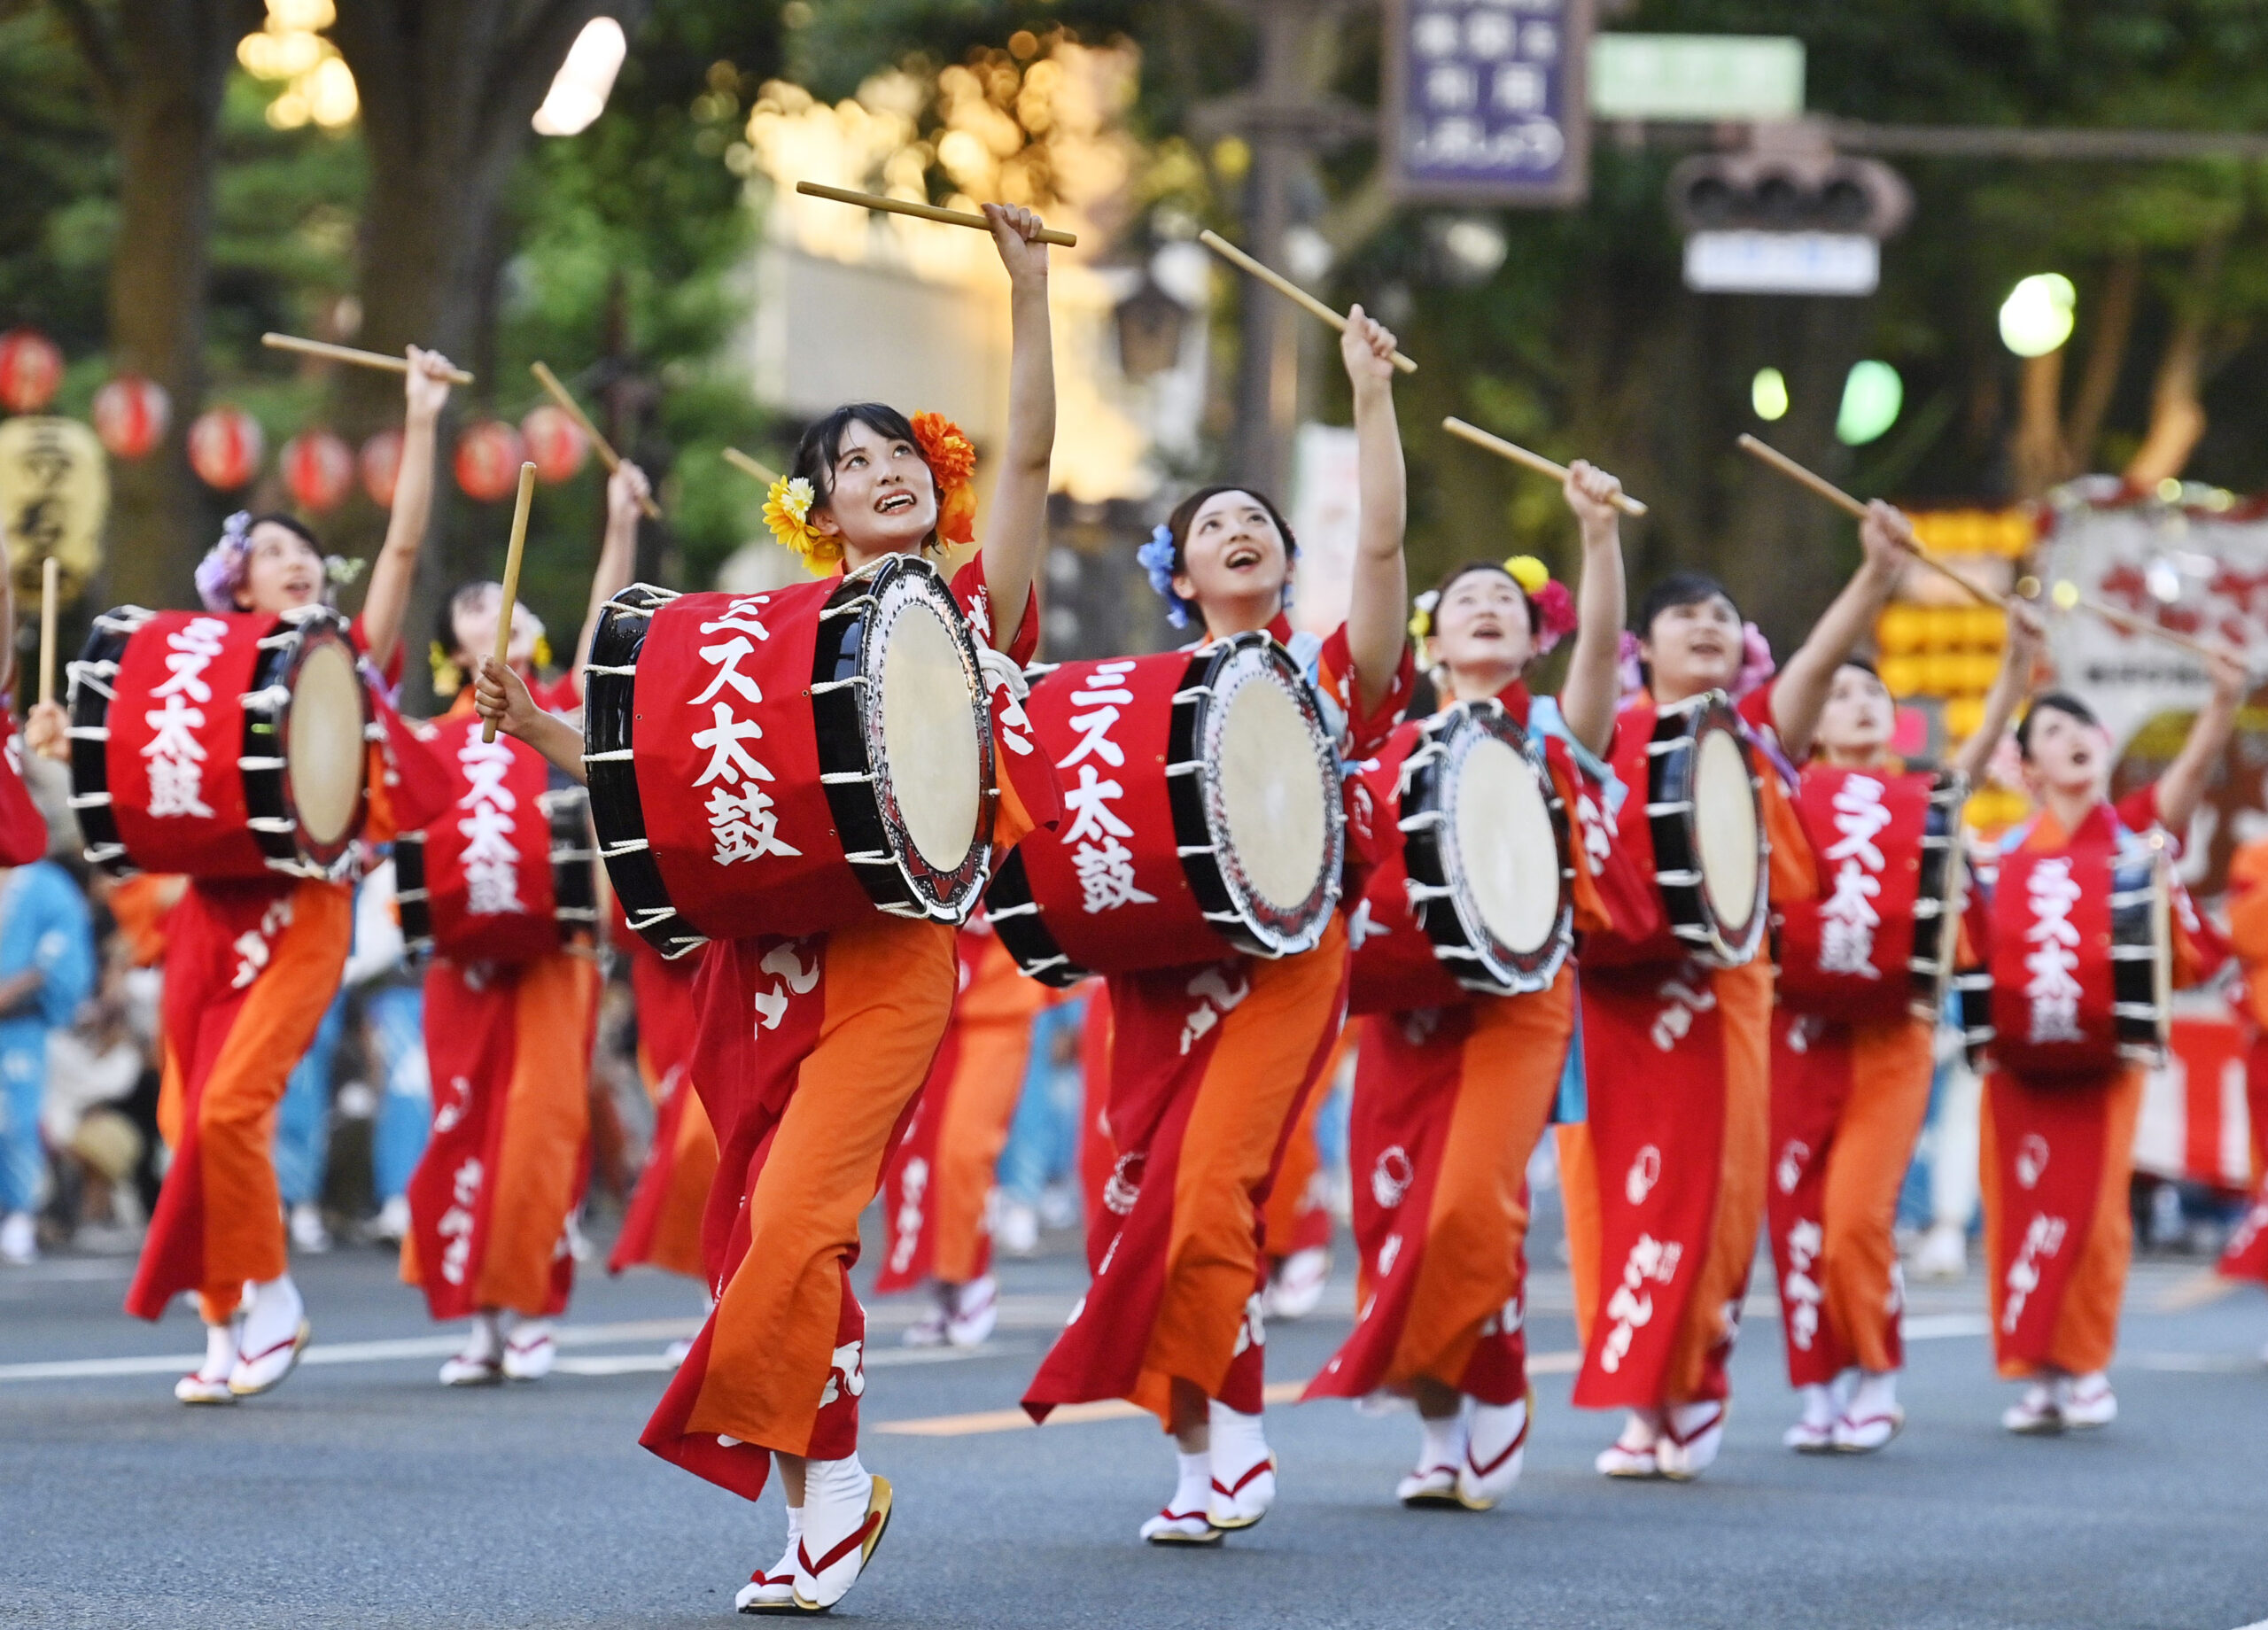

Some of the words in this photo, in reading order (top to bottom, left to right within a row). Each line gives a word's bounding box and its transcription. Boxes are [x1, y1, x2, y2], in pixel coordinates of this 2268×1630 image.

[139, 617, 229, 819] ミス太鼓
[687, 594, 804, 866] ミス太鼓
[1055, 661, 1160, 914] ミス太鼓
